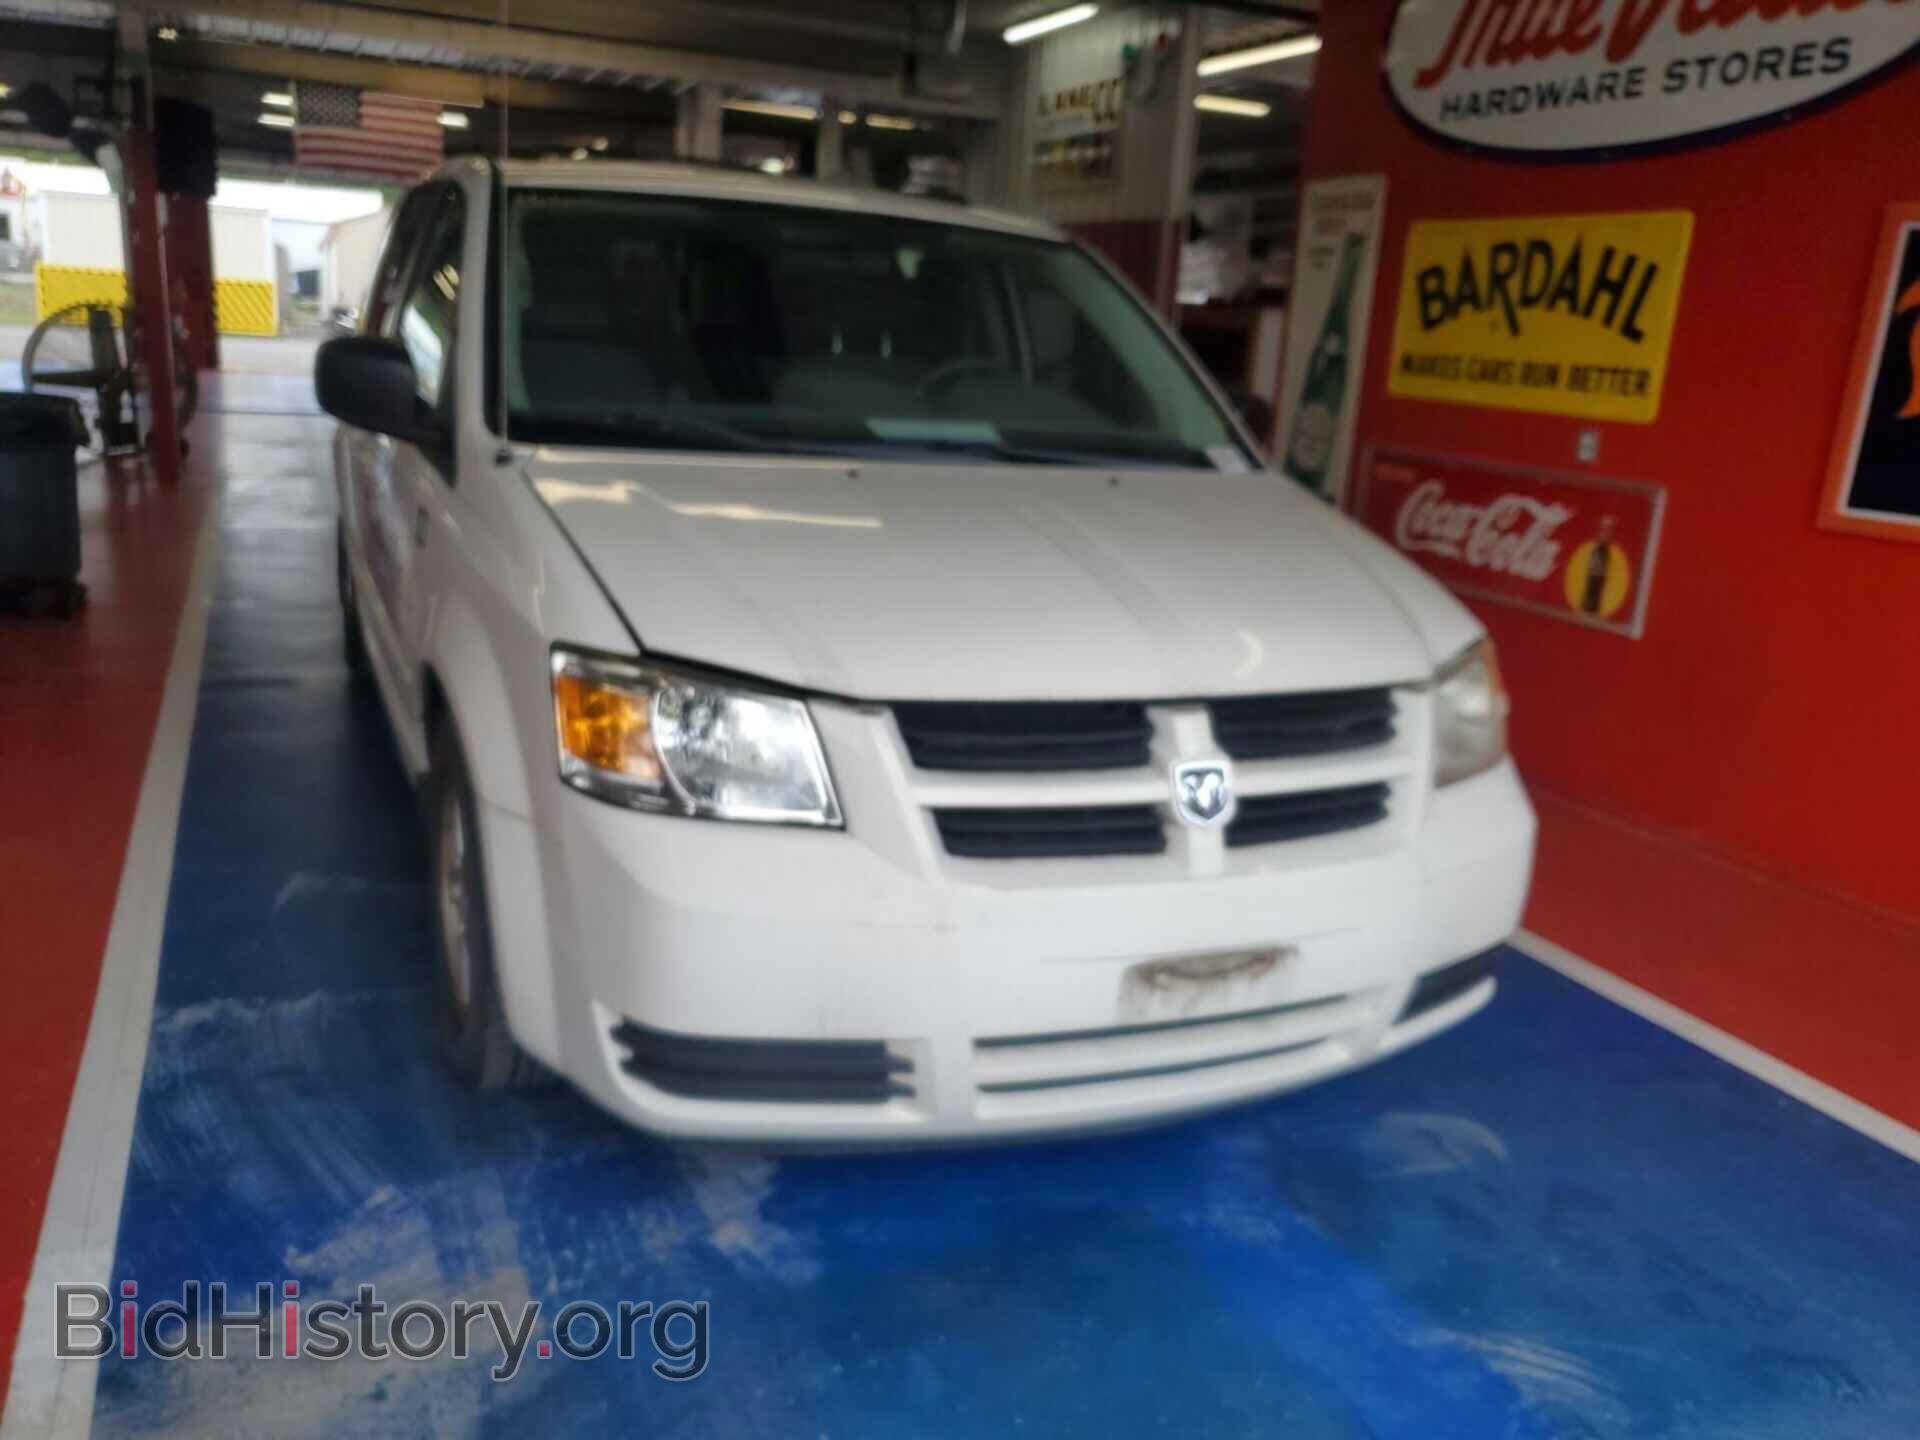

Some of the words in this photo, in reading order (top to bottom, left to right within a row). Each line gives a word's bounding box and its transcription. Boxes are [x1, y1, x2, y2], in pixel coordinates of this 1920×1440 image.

[1440, 67, 1647, 122] HARDWARE
[1661, 37, 1852, 94] STORES
[1416, 235, 1659, 343] BARDAHL
[1567, 364, 1652, 397] BETTER
